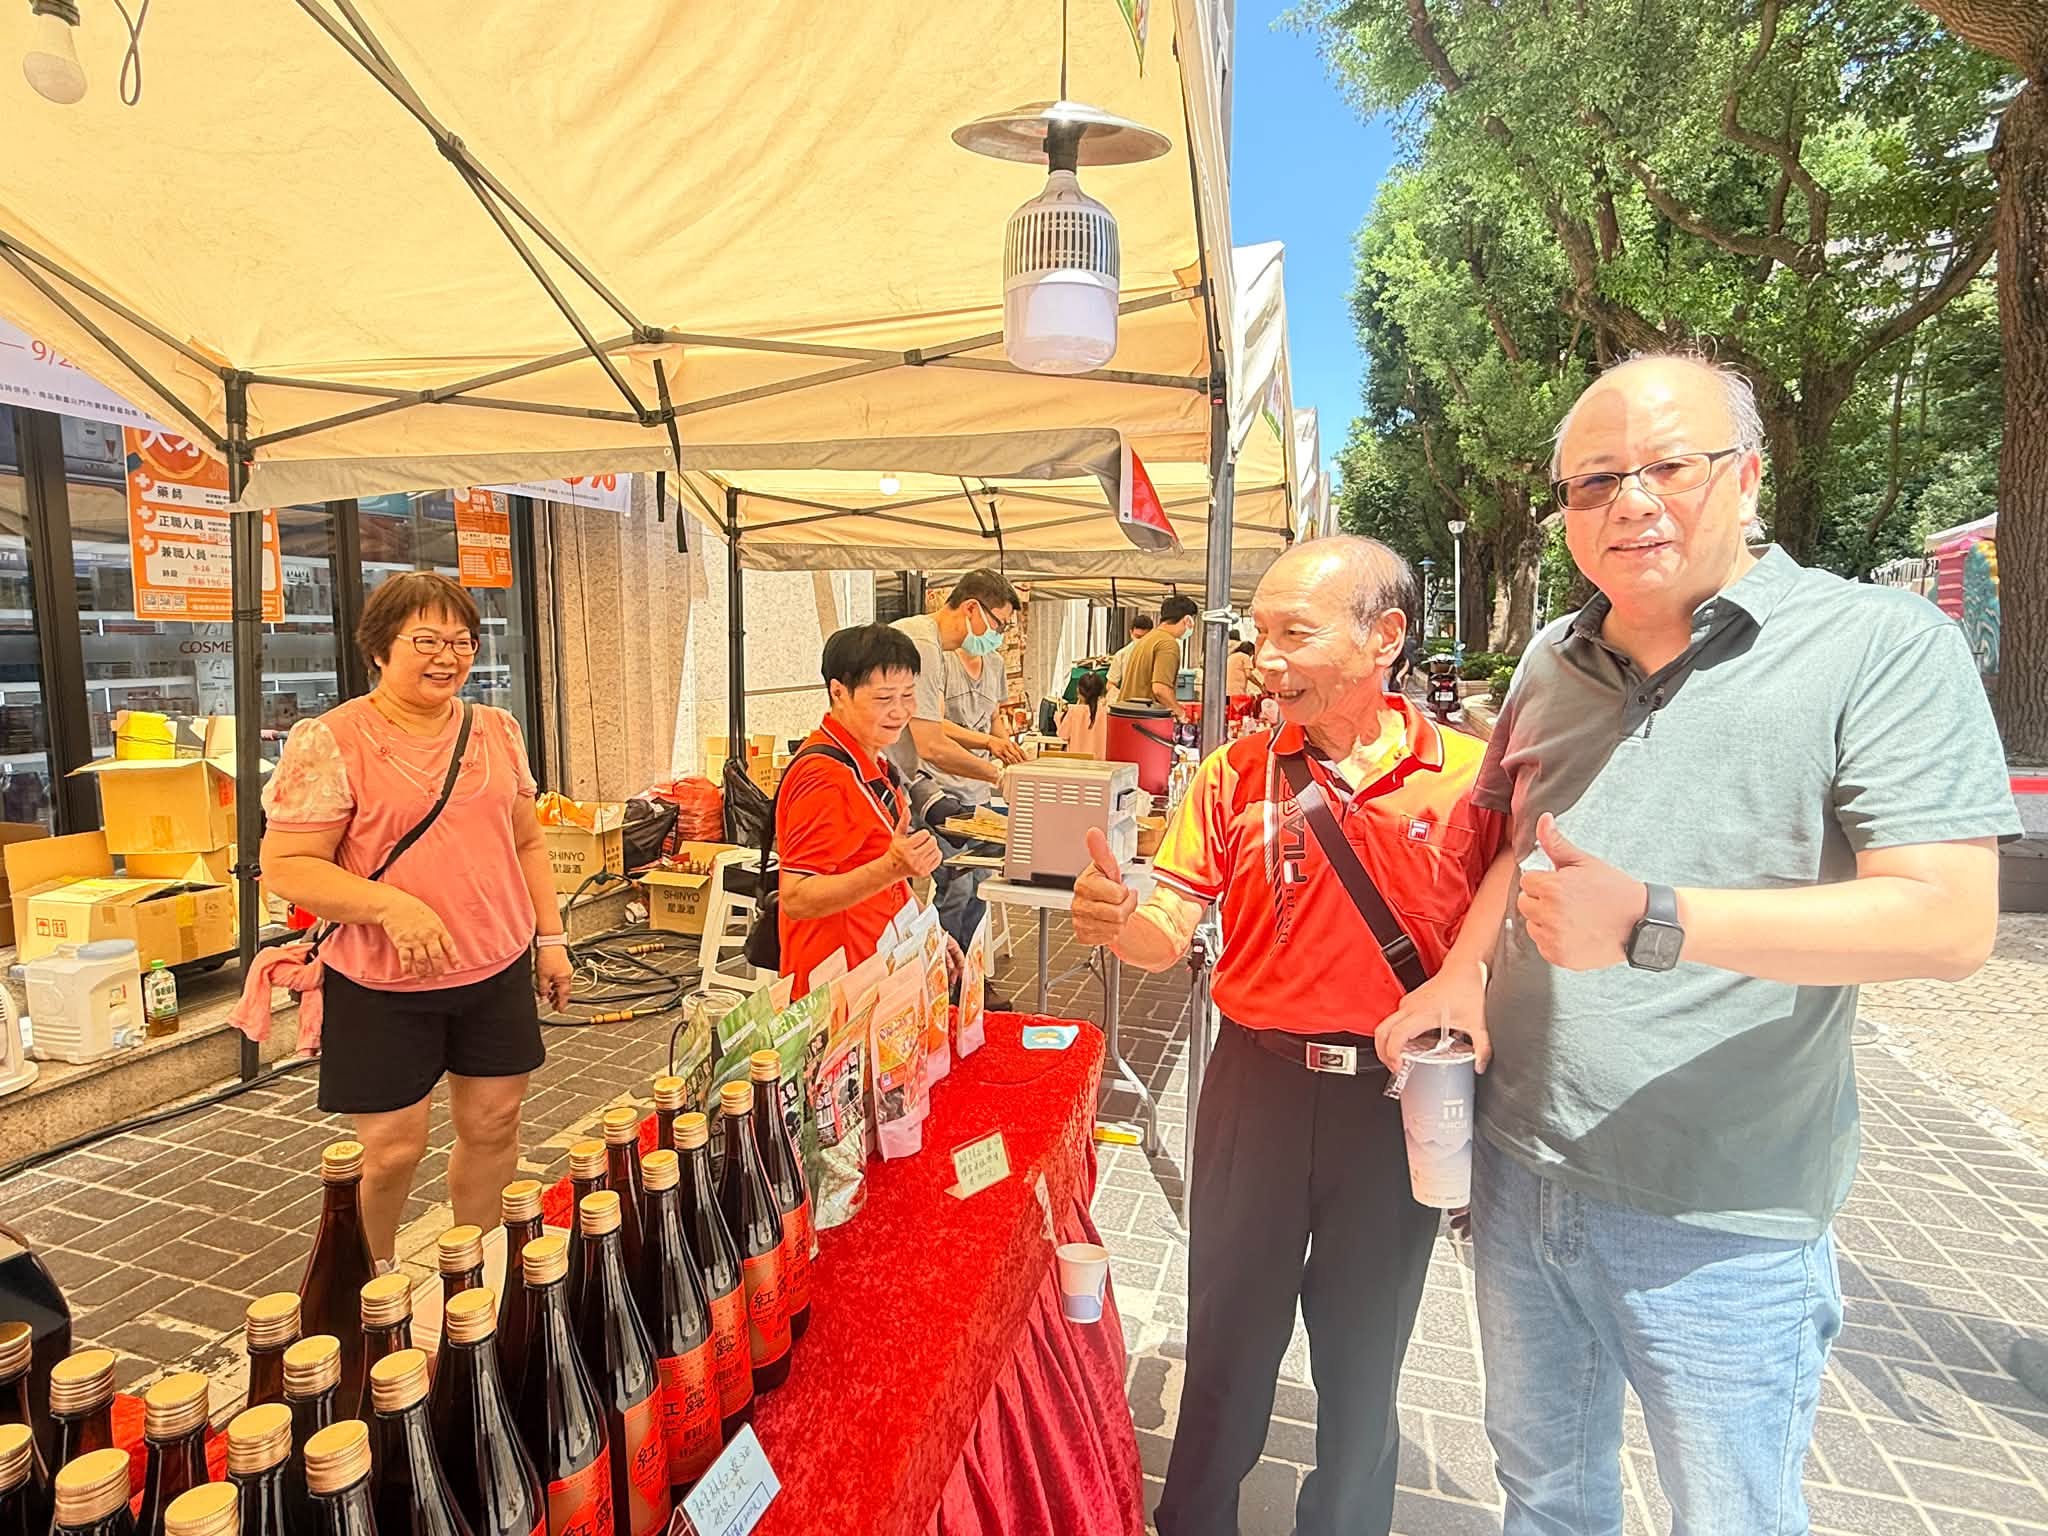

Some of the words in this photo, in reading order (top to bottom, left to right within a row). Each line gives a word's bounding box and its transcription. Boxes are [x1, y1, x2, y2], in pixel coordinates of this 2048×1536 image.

[159, 515, 205, 531] 正職人員
[161, 546, 207, 561] 兼職人員
[179, 640, 233, 654] COSME
[549, 850, 585, 862] SHINYO
[663, 889, 700, 903] SHINYO
